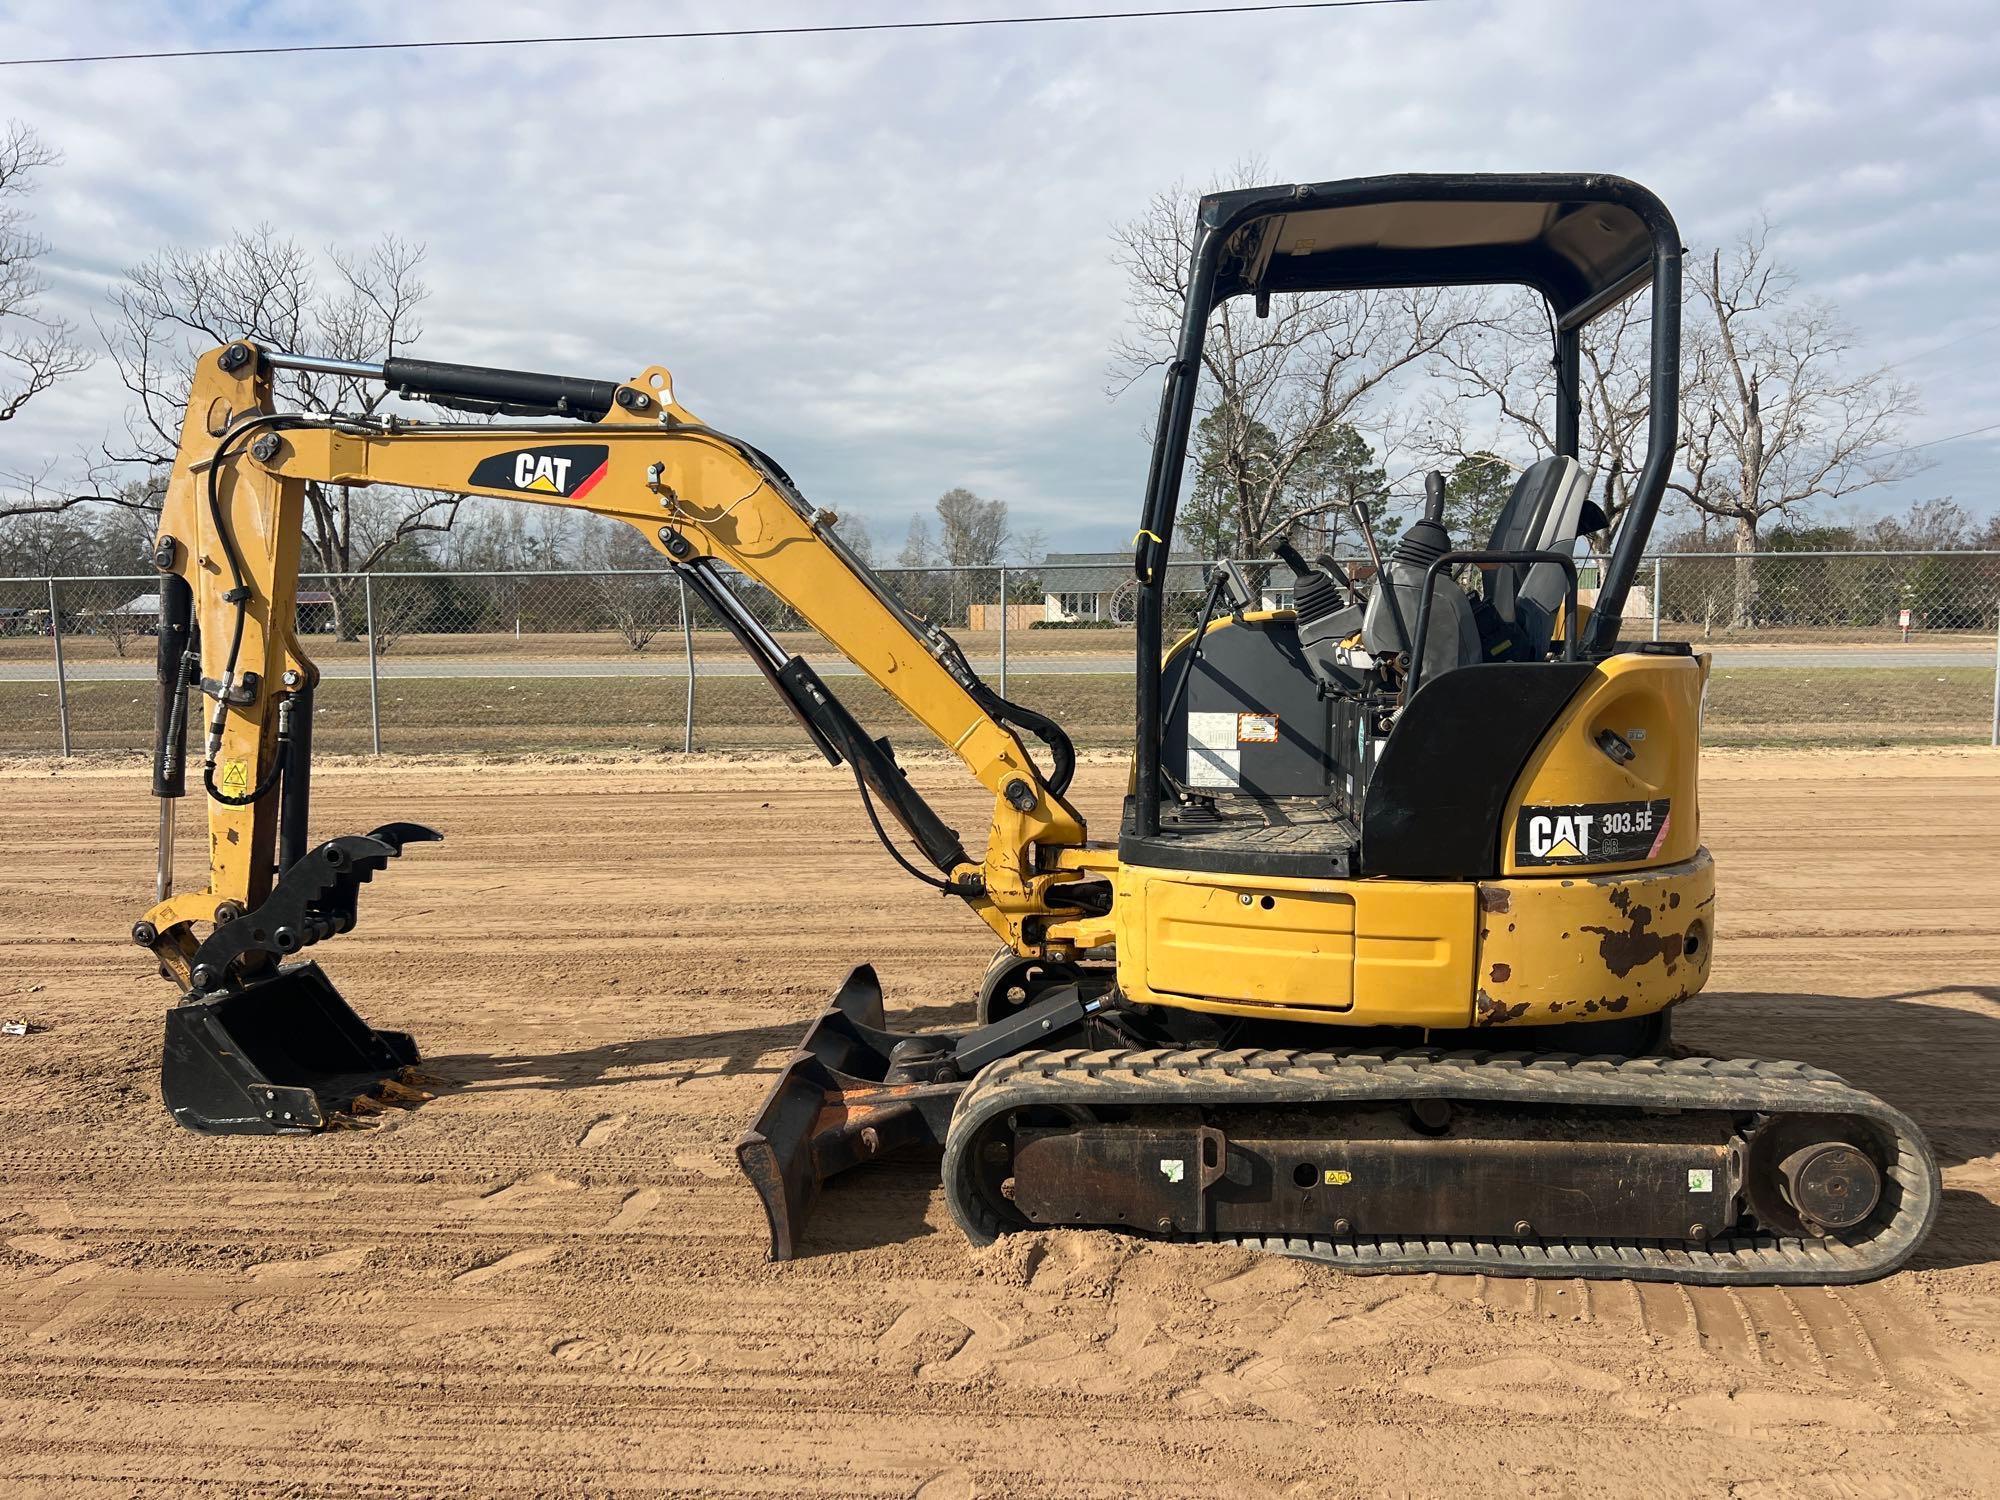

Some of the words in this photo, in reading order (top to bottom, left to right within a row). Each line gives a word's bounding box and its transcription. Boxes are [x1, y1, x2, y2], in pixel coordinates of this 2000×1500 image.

[514, 452, 572, 494] CAT
[1529, 815, 1594, 857] CAT
[1602, 811, 1652, 834] 303.5E
[1602, 838, 1619, 855] CR
